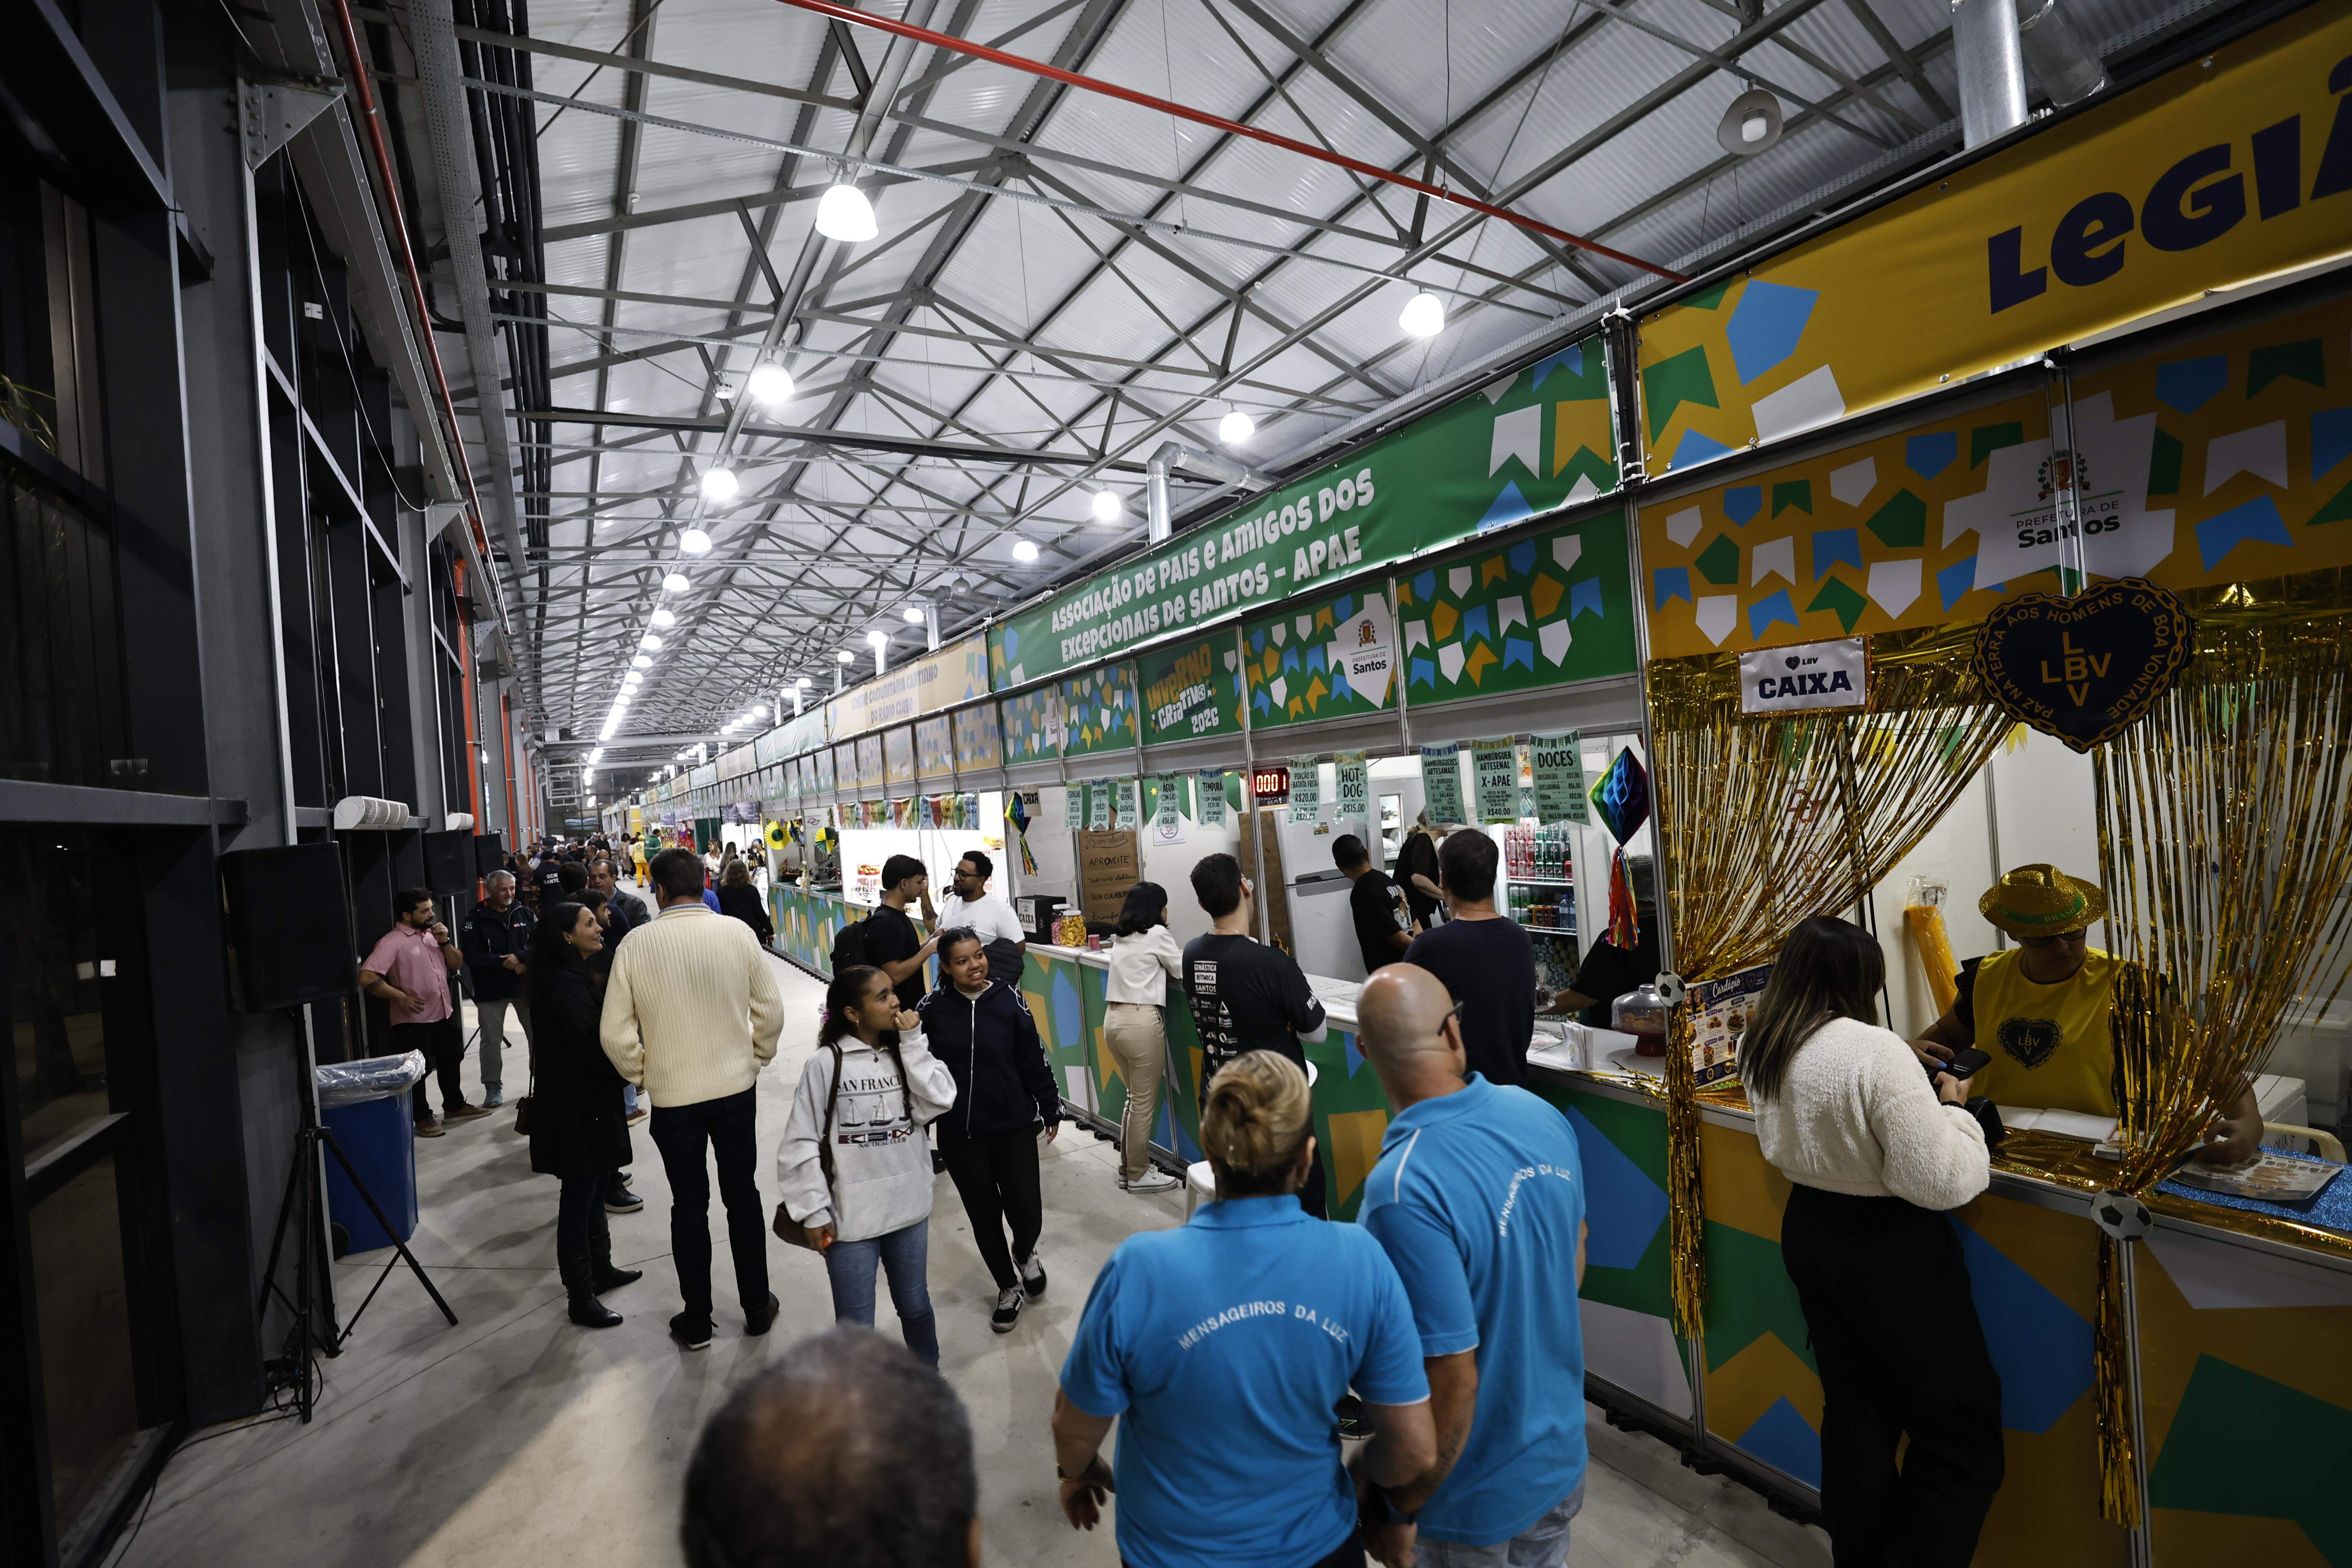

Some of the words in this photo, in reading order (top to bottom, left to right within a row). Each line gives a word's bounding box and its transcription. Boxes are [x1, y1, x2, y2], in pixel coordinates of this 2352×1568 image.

[2017, 506, 2096, 528] PREFETURA
[2101, 501, 2119, 511] DE
[1159, 551, 1200, 590] PAIS
[1318, 468, 1375, 523] DOS
[1293, 525, 1362, 582] APAE
[2047, 592, 2123, 624] HOMENS
[2131, 593, 2156, 613] DE
[2006, 607, 2039, 626] AOS
[2152, 614, 2170, 648] BOA
[1352, 653, 1377, 663] PREFEITURA
[1989, 630, 2006, 680] TERRA
[1353, 659, 1387, 675] Santos
[1759, 670, 1853, 699] CAIXA
[2003, 679, 2023, 700] NA
[2106, 654, 2165, 719] VONTADE
[2022, 697, 2054, 719] PAZ
[871, 710, 878, 724] DO
[1191, 707, 1219, 734] 2026
[1477, 751, 1512, 762] HAMBÚRGUER
[1537, 750, 1573, 768] DOCES
[1294, 771, 1310, 780] PORÇÃO
[1310, 771, 1315, 779] DE
[1342, 768, 1364, 783] HOT-
[1427, 767, 1455, 775] ARTESANAIS
[1163, 782, 1174, 793] ÁGUA
[1202, 780, 1223, 792] TEMPURÁ
[1293, 780, 1307, 789] BATATA
[1343, 784, 1363, 798] DOG
[1295, 793, 1316, 803] R$20,00
[1090, 856, 1129, 867] APROVEITE
[1019, 913, 1034, 924] CAIXA
[1194, 963, 1216, 972] GINÁSTICA
[1196, 984, 1216, 993] SANTOS
[1713, 976, 1741, 998] Cardápio
[861, 1074, 901, 1091] FRANCI
[858, 1140, 889, 1148] NAUTICAL
[1538, 1164, 1553, 1175] DA
[1178, 1300, 1286, 1351] MENSAGEIROS
[1294, 1304, 1317, 1324] DA
[1321, 1318, 1348, 1343] LUZ
